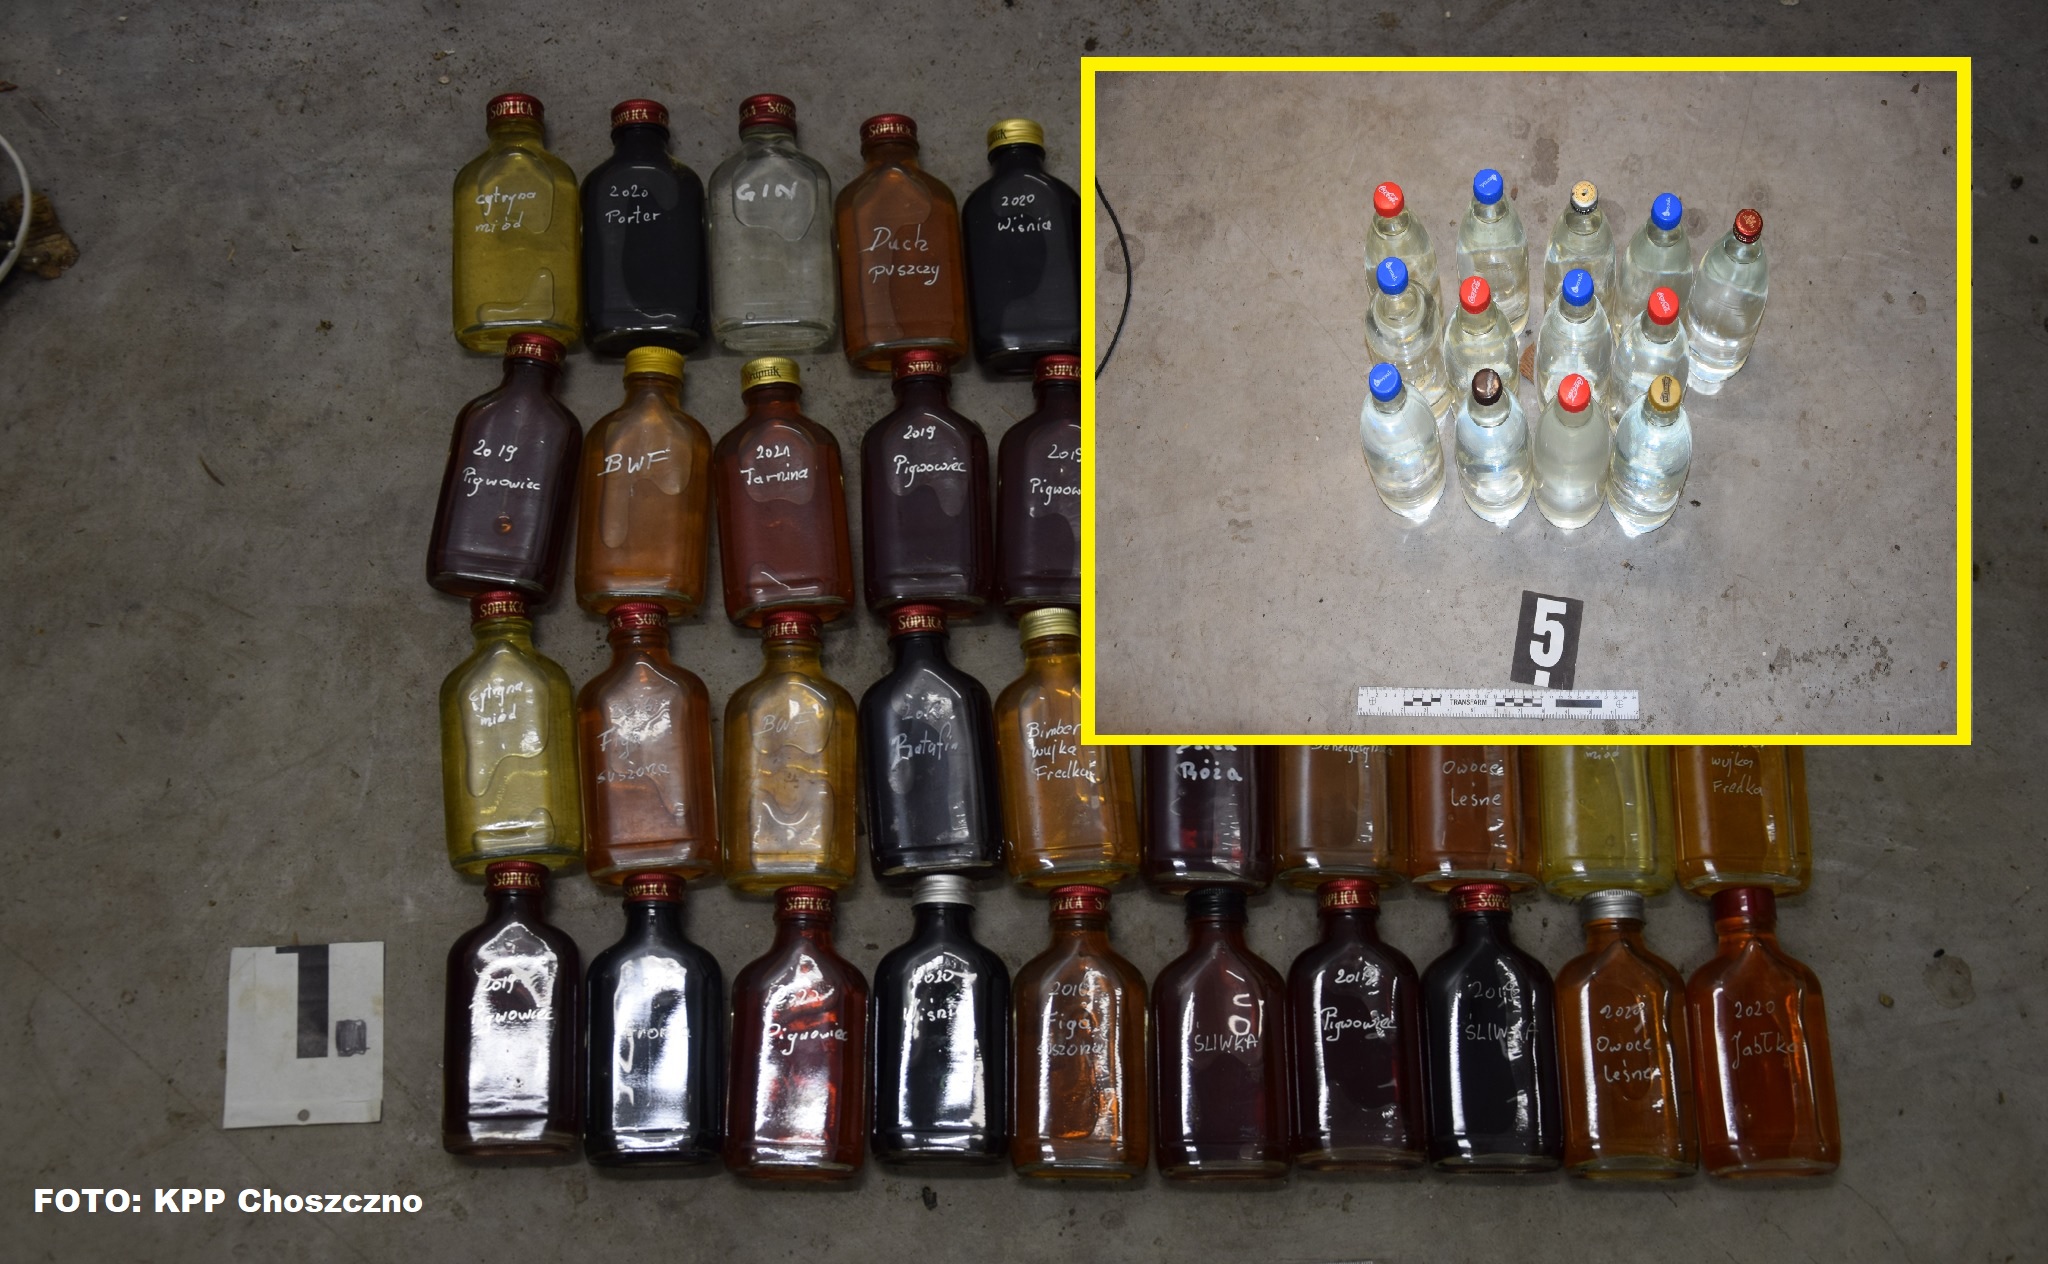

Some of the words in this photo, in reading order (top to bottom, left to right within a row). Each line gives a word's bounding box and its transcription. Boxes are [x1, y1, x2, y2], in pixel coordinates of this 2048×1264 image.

[490, 101, 533, 119] SOPLICA
[609, 185, 649, 198] 2020
[735, 181, 799, 201] GIN
[1001, 193, 1036, 207] 2020
[605, 206, 661, 224] Porter
[864, 224, 929, 252] Duch
[868, 263, 941, 286] puszczy
[473, 440, 518, 462] 2019
[597, 447, 673, 477] BWF
[1029, 477, 1081, 506] Pigwow
[1734, 1000, 1776, 1019] 2020
